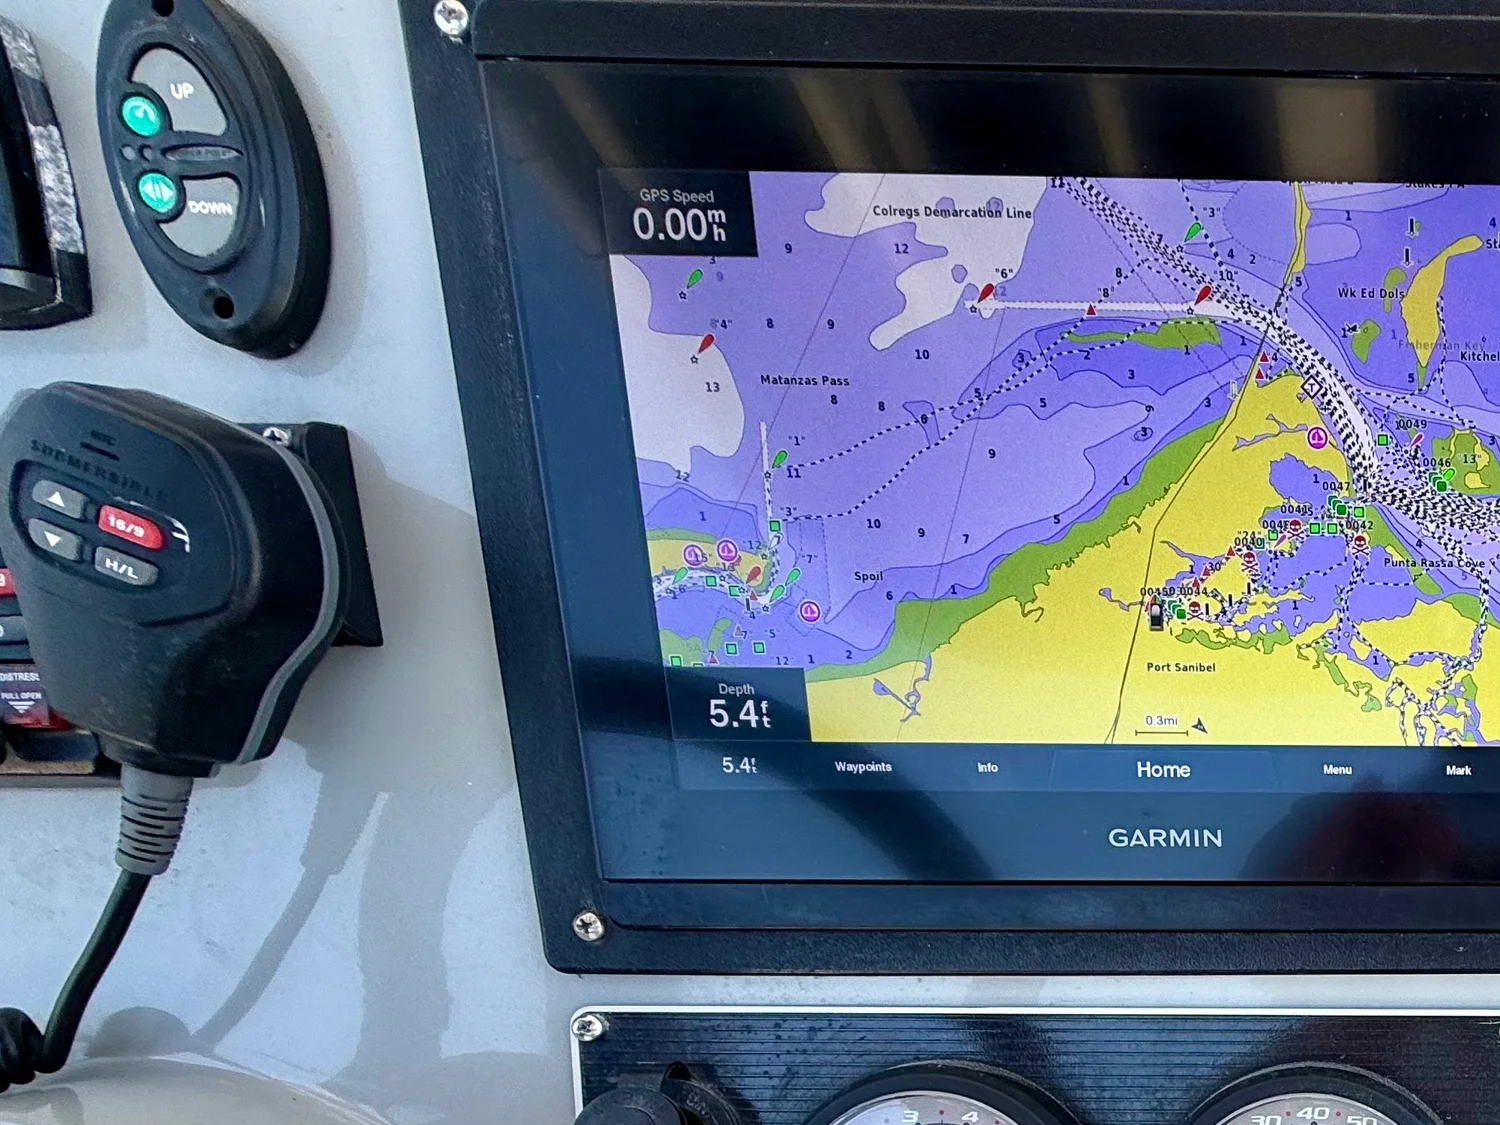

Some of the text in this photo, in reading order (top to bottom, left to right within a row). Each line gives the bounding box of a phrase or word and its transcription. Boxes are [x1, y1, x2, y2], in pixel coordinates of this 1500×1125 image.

[171, 82, 194, 99] UP
[640, 189, 714, 205] GPS Speed
[188, 201, 232, 215] DOWN
[873, 205, 1032, 219] Colregs Demarcation Line
[1345, 211, 1352, 220] 1
[633, 208, 708, 241] 0.00
[1489, 218, 1497, 228] 4
[785, 243, 793, 254] 9
[894, 244, 909, 254] 12
[1227, 249, 1235, 259] 4
[1249, 255, 1256, 265] 2
[1115, 268, 1122, 278] 8
[1295, 277, 1303, 287] 5
[1338, 288, 1405, 299] Wk Ed Dols
[766, 319, 774, 329] 8
[827, 320, 835, 329] 9
[915, 350, 930, 360] 10
[1084, 351, 1091, 360] 2
[1460, 351, 1500, 362] Kitchel
[1128, 370, 1135, 379] 3
[1408, 373, 1415, 383] 5
[761, 375, 850, 386] Matanzas Pass
[705, 382, 720, 392] 13
[974, 388, 981, 398] 5
[830, 395, 838, 405] 8
[1040, 398, 1047, 408] 5
[1204, 398, 1211, 408] 3
[878, 401, 885, 411] 8
[920, 414, 928, 424] 6
[1489, 436, 1496, 446] 3
[988, 449, 996, 459] 9
[1423, 458, 1451, 467] 0046
[787, 469, 801, 479] 11
[1322, 482, 1350, 491] 0047
[867, 519, 881, 529] 10
[1053, 514, 1061, 524] 5
[108, 514, 145, 538] 16/9
[918, 528, 925, 538] 9
[962, 534, 970, 544] 7
[1384, 558, 1485, 569] Punta Rassa Cove
[105, 558, 138, 580] H/L
[855, 571, 883, 582] Spoil
[886, 591, 894, 601] 6
[808, 654, 815, 664] 1
[846, 650, 853, 660] 2
[1372, 656, 1379, 665] 1
[1147, 662, 1216, 672] Port Sanibel
[719, 684, 755, 697] Depth
[709, 700, 759, 728] 5.4
[723, 757, 750, 773] 5.4
[835, 762, 892, 774] Waypoints
[977, 762, 999, 773] Info
[1137, 762, 1191, 777] Home
[1323, 765, 1352, 775] Menu
[1447, 765, 1472, 776] Mark
[1108, 828, 1223, 848] GARMIN
[901, 1111, 919, 1122] 3
[962, 1111, 979, 1123] 4
[1296, 1107, 1331, 1119] 40
